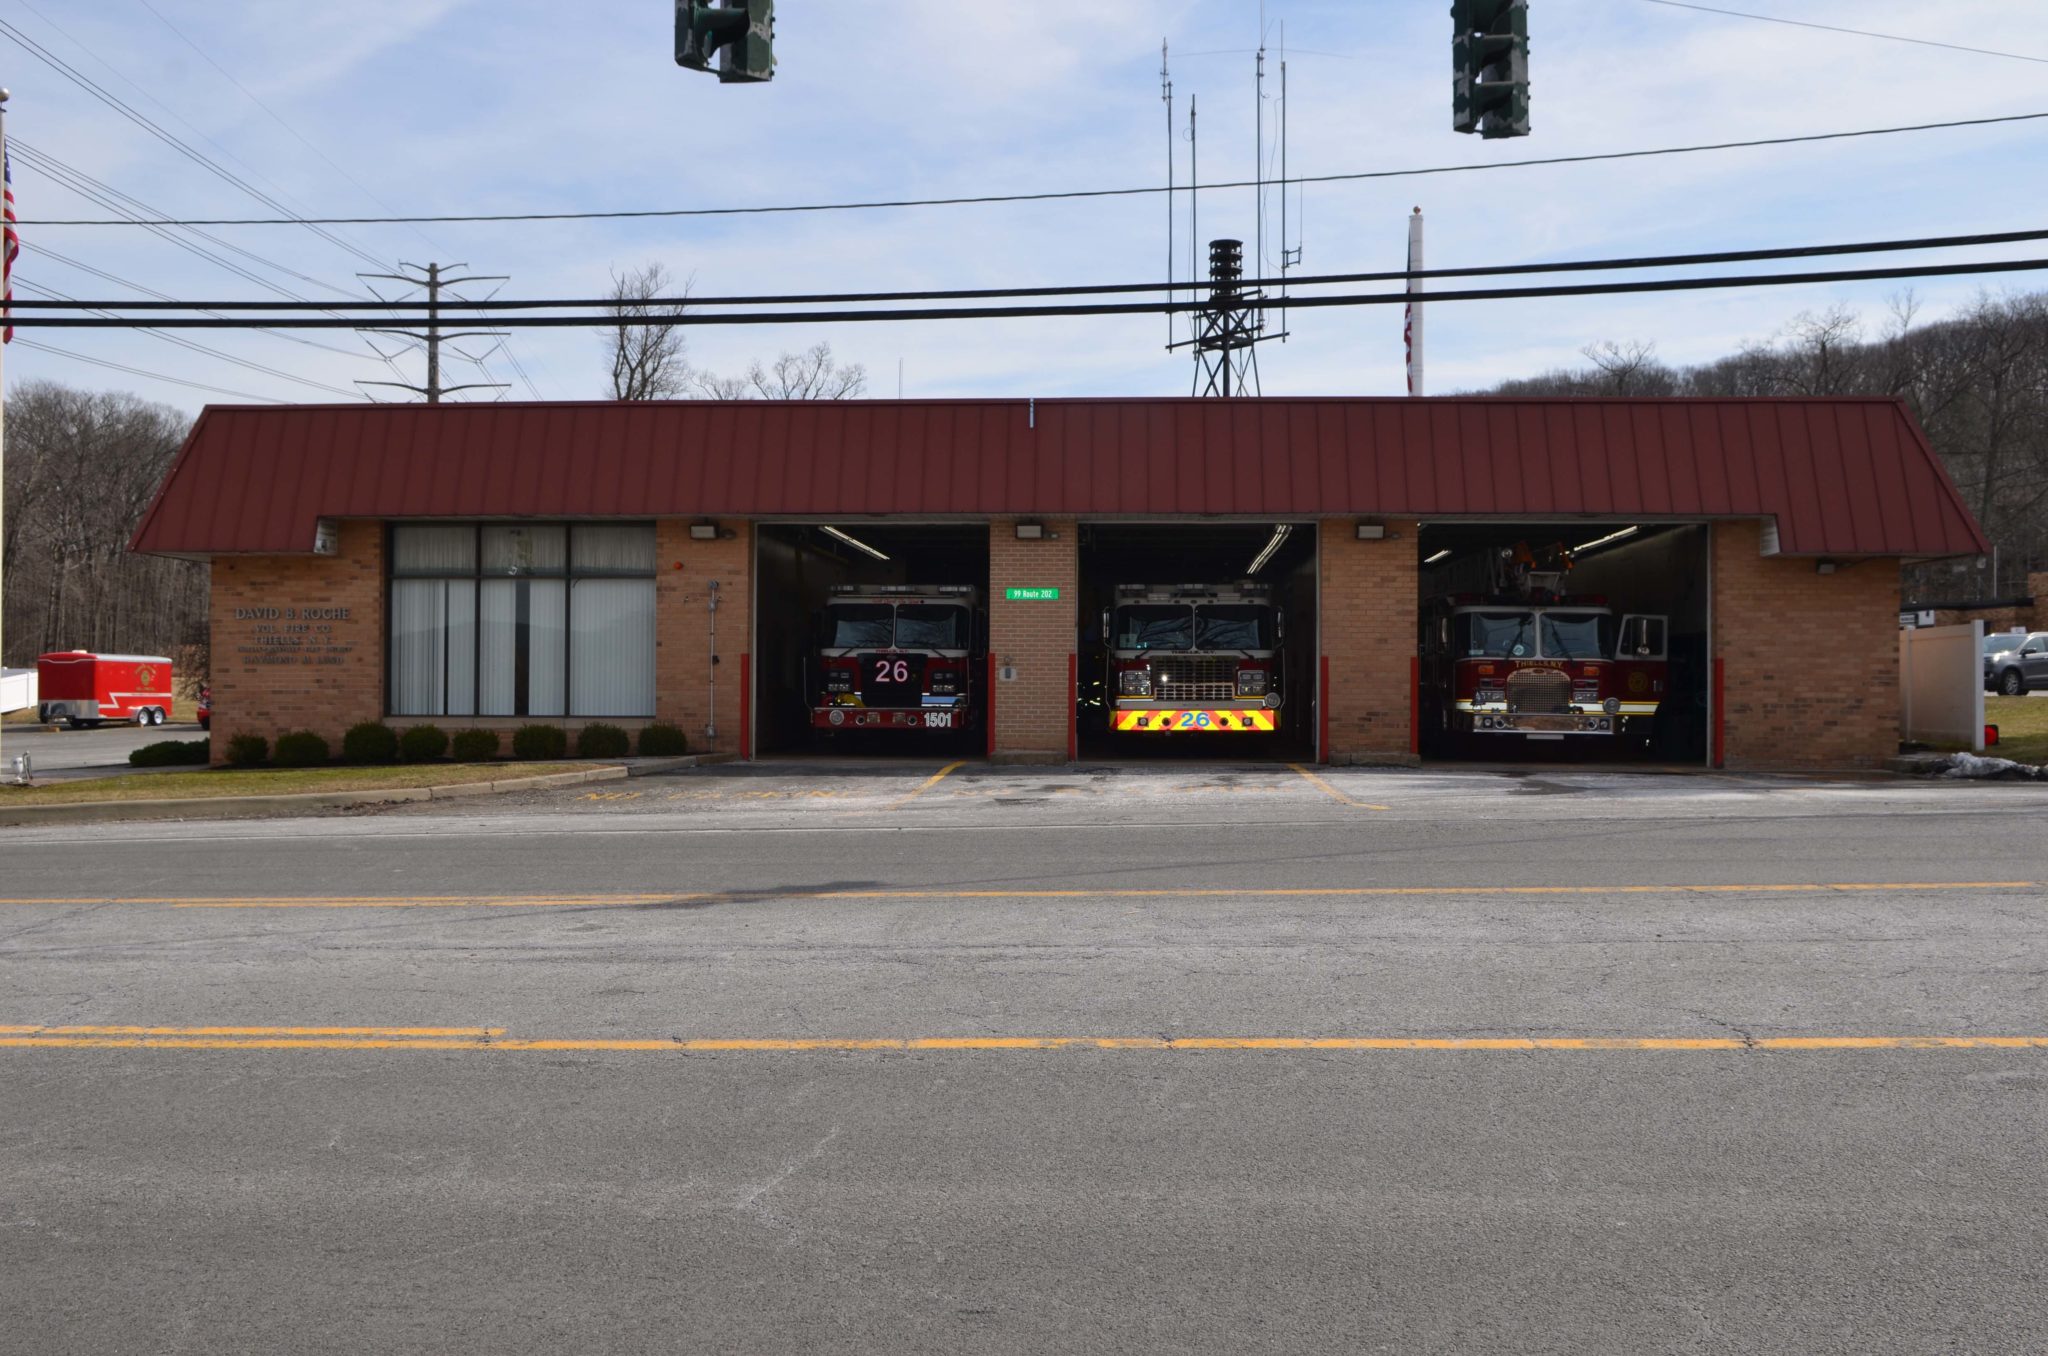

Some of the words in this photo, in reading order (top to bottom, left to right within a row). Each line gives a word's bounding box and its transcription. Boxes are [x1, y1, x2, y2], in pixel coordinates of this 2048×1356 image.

[1013, 590, 1021, 598] 99
[1022, 590, 1039, 598] Route
[1041, 590, 1052, 598] 202
[235, 607, 280, 620] DAVID
[302, 607, 350, 620] ROCHE
[284, 624, 308, 633] FIRE
[875, 660, 909, 683] 26
[923, 712, 952, 728] 1501
[1181, 712, 1209, 726] 26
